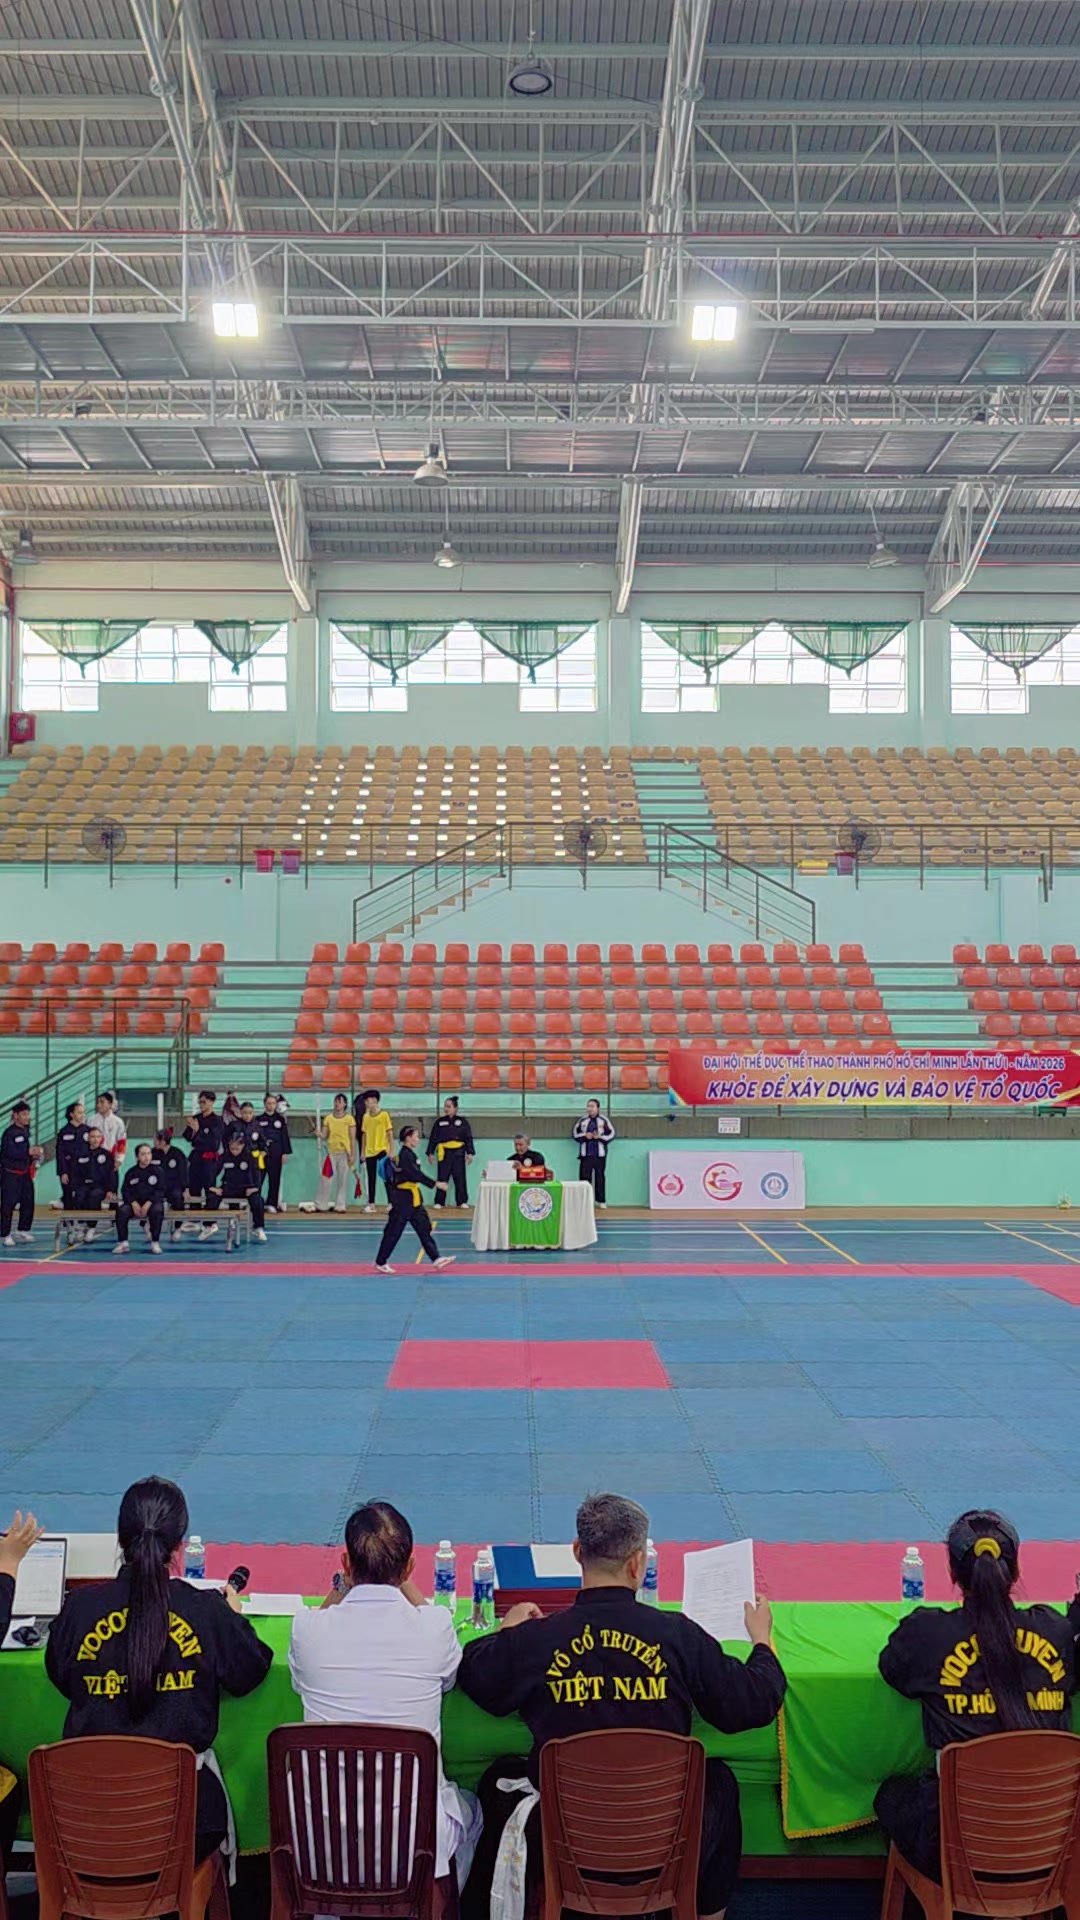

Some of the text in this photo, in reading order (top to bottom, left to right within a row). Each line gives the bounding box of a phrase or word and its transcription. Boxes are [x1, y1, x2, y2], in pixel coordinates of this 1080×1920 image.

[704, 1056, 721, 1071] ĐẠI
[723, 1054, 741, 1072] HỘI
[765, 1056, 784, 1071] DỤC
[808, 1056, 834, 1069] THAO
[837, 1053, 870, 1069] THÀNH
[873, 1051, 894, 1069] PHỐ
[896, 1052, 911, 1069] HỒ
[913, 1052, 930, 1069] CHÍ
[932, 1056, 958, 1069] MINH
[982, 1053, 1003, 1069] THỨ
[1015, 1053, 1038, 1069] NĂM
[1041, 1057, 1065, 1070] 2026
[707, 1073, 1062, 1102] KHỎE ĐỂ XÂY DỰNG VÀ BẢO VỆ TỔ QUỐC
[546, 1648, 571, 1678] VÕ
[546, 1670, 669, 1708] VIỆT NAM
